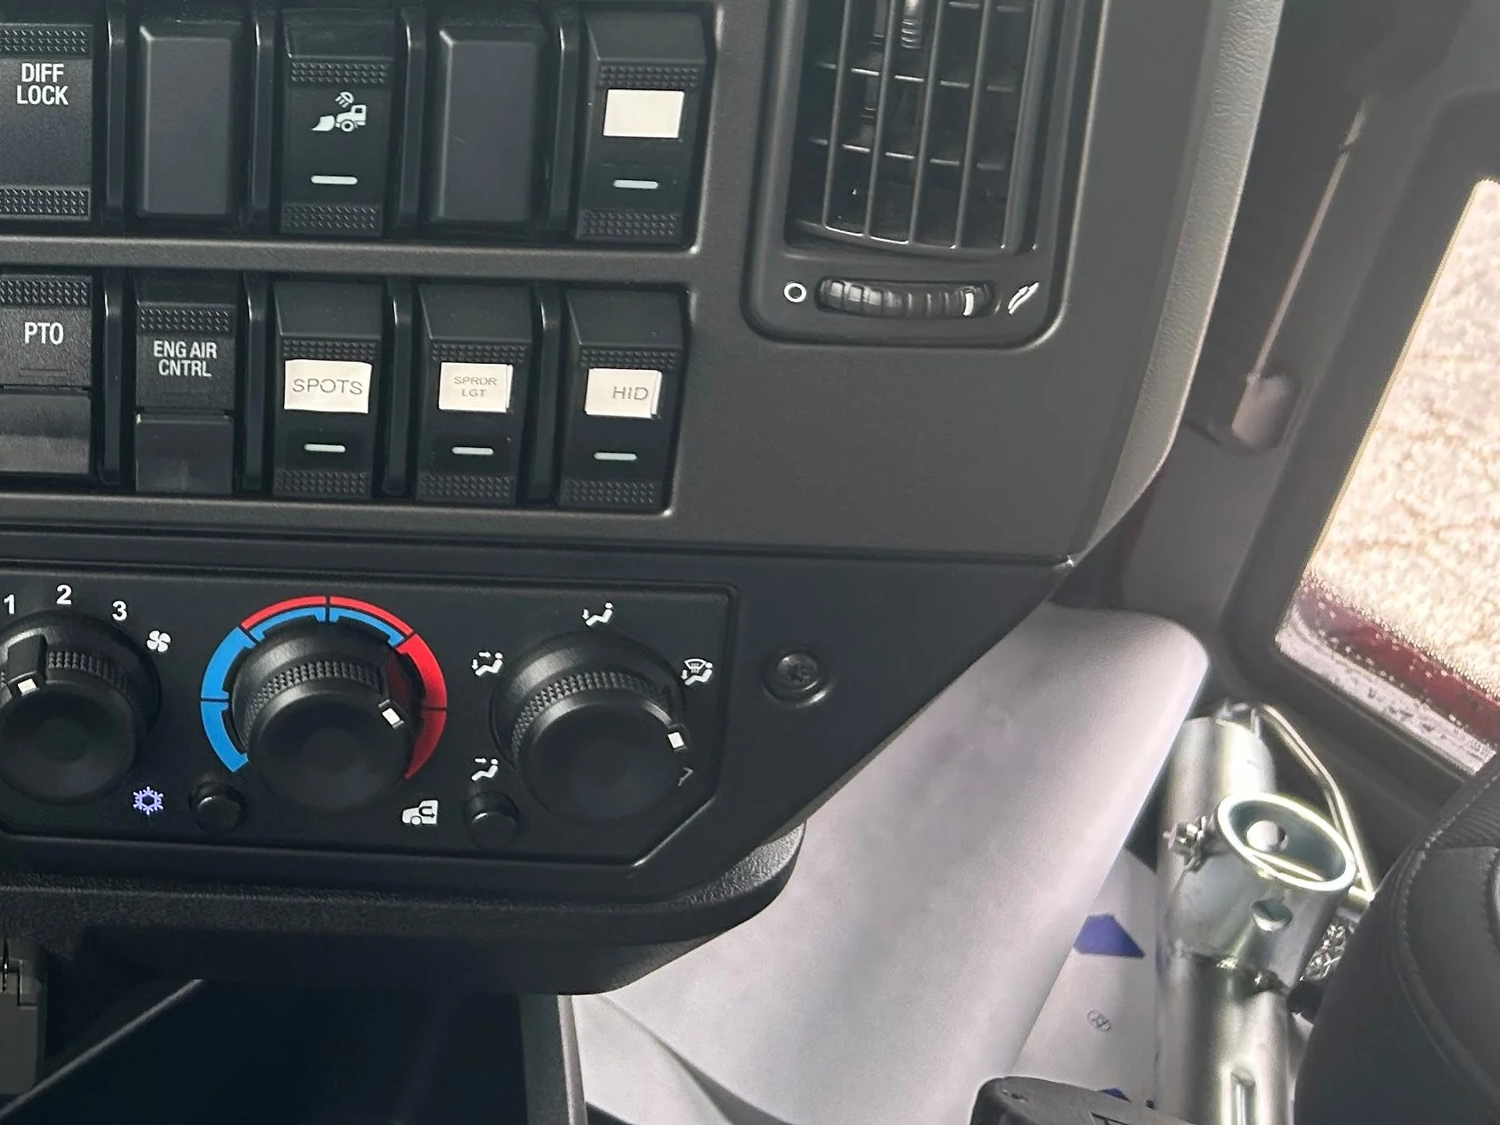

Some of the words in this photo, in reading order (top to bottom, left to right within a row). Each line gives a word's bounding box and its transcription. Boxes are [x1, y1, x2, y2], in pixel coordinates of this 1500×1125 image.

[21, 63, 64, 82] DIFF
[16, 85, 68, 105] LOCK
[24, 322, 64, 345] PTO
[153, 341, 187, 357] ENG
[189, 342, 217, 359] AIR
[158, 359, 212, 377] CNTRL
[292, 378, 363, 396] SPOTS
[461, 389, 486, 398] LGT
[612, 386, 649, 400] HID
[4, 594, 15, 614] 1
[56, 584, 72, 605] 2
[112, 601, 128, 621] 3
